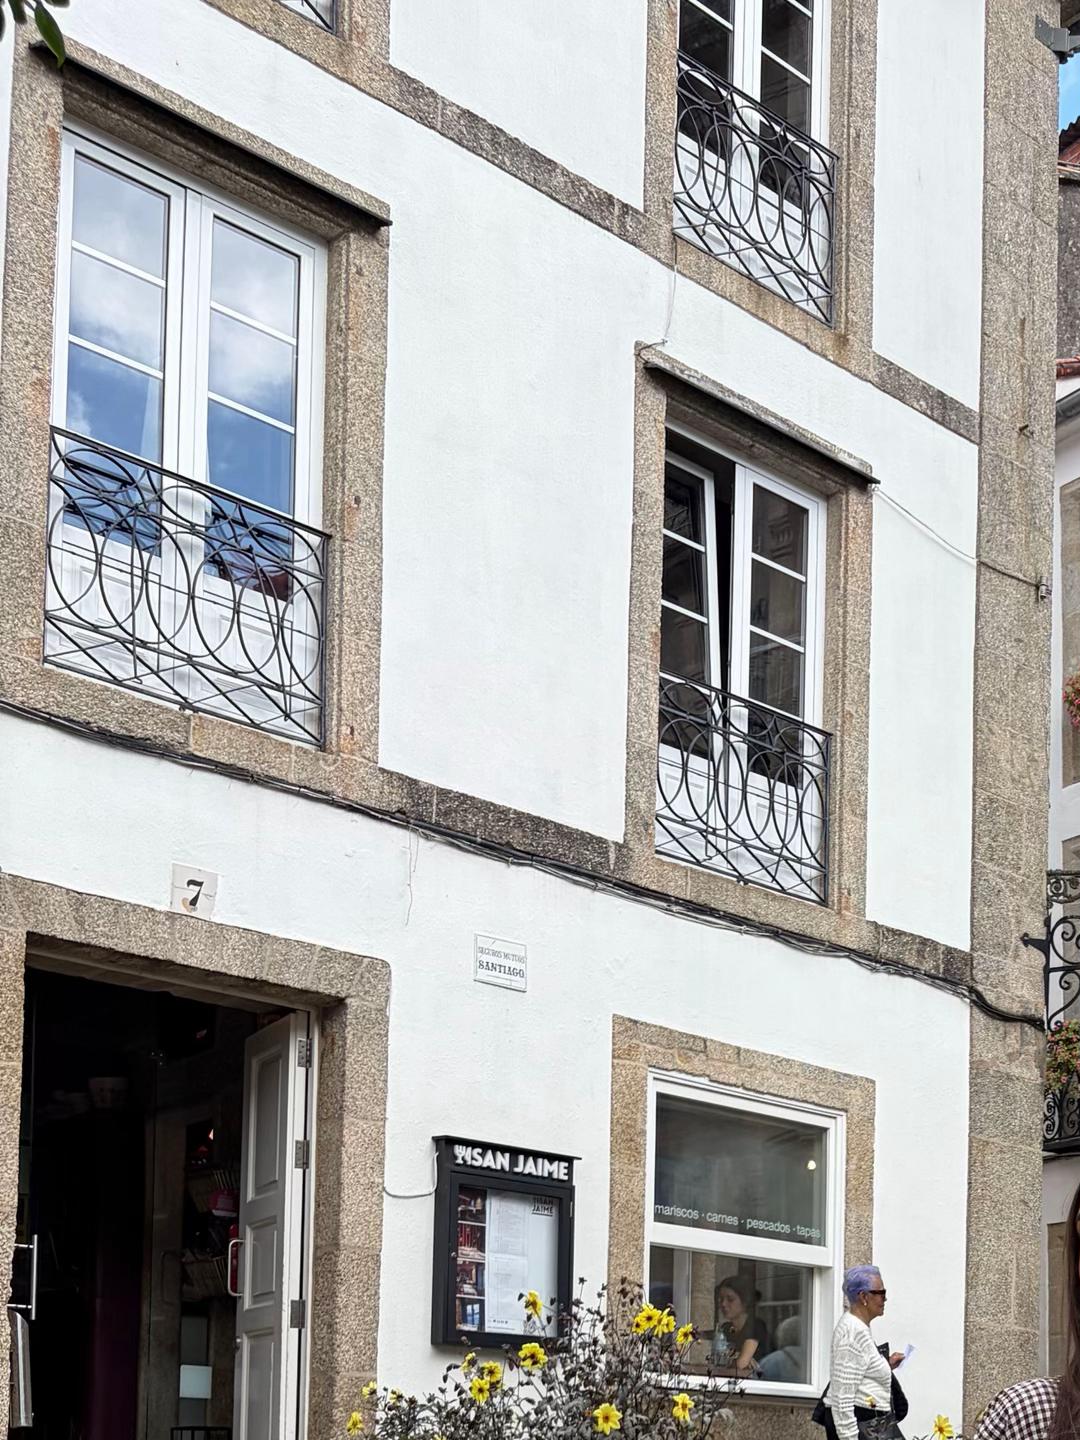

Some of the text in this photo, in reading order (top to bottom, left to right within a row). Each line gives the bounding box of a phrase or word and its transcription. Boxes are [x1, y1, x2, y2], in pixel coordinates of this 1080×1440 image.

[186, 879, 204, 907] 7
[478, 959, 525, 978] SANTIAGO
[472, 1147, 569, 1181] SAN JAIME
[654, 1203, 822, 1240] mariscos carnes pescados tapas
